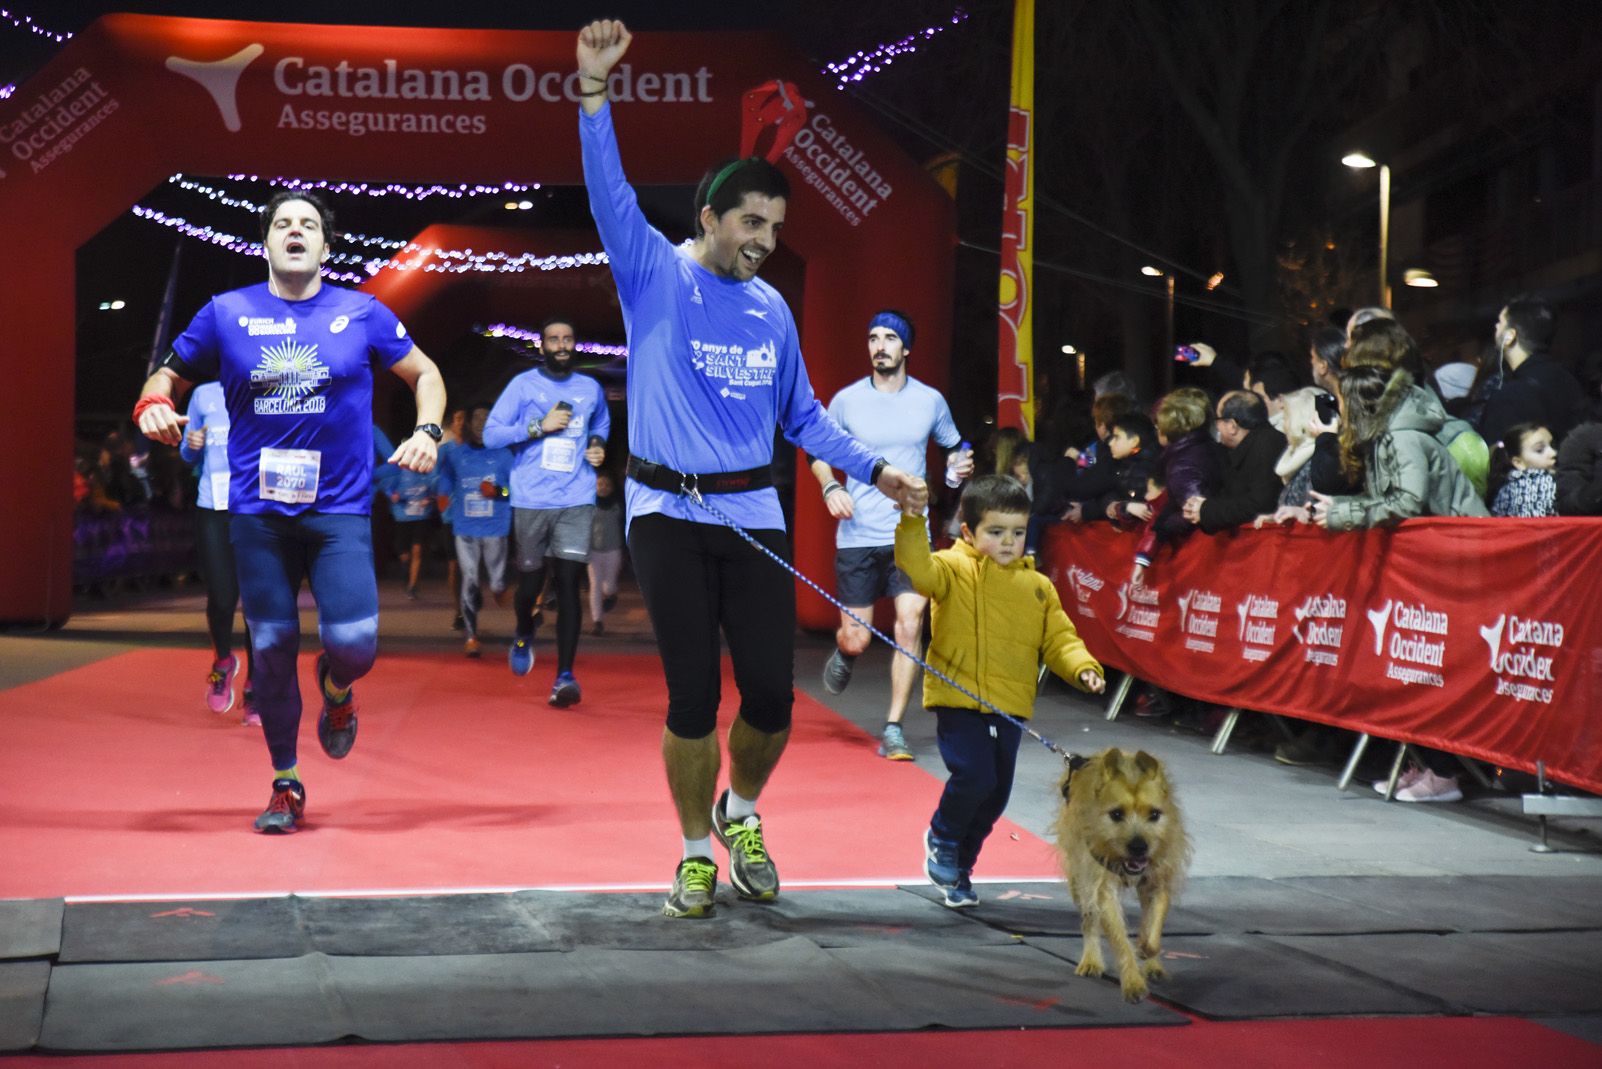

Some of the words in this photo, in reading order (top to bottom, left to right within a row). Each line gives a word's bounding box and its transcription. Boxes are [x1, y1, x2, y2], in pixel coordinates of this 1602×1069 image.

[274, 56, 492, 101] Catalana
[502, 63, 713, 102] Occdent
[0, 67, 93, 142] Catalana
[12, 81, 109, 160] Occident
[277, 103, 487, 136] Assegurances
[794, 128, 878, 217] Occident
[811, 114, 893, 200] Catalana
[783, 145, 861, 226] Assegurances
[702, 343, 727, 356] anys
[729, 344, 743, 355] de
[705, 353, 746, 368] SANT
[705, 365, 776, 381] SILVESTRE
[254, 397, 301, 415] BARCELONA
[303, 395, 326, 413] 2018
[275, 475, 306, 489] 2070
[1394, 601, 1448, 635] Catalana
[1509, 615, 1564, 648] Catana
[1390, 632, 1445, 667] Occident
[1386, 661, 1444, 688] Assegurances
